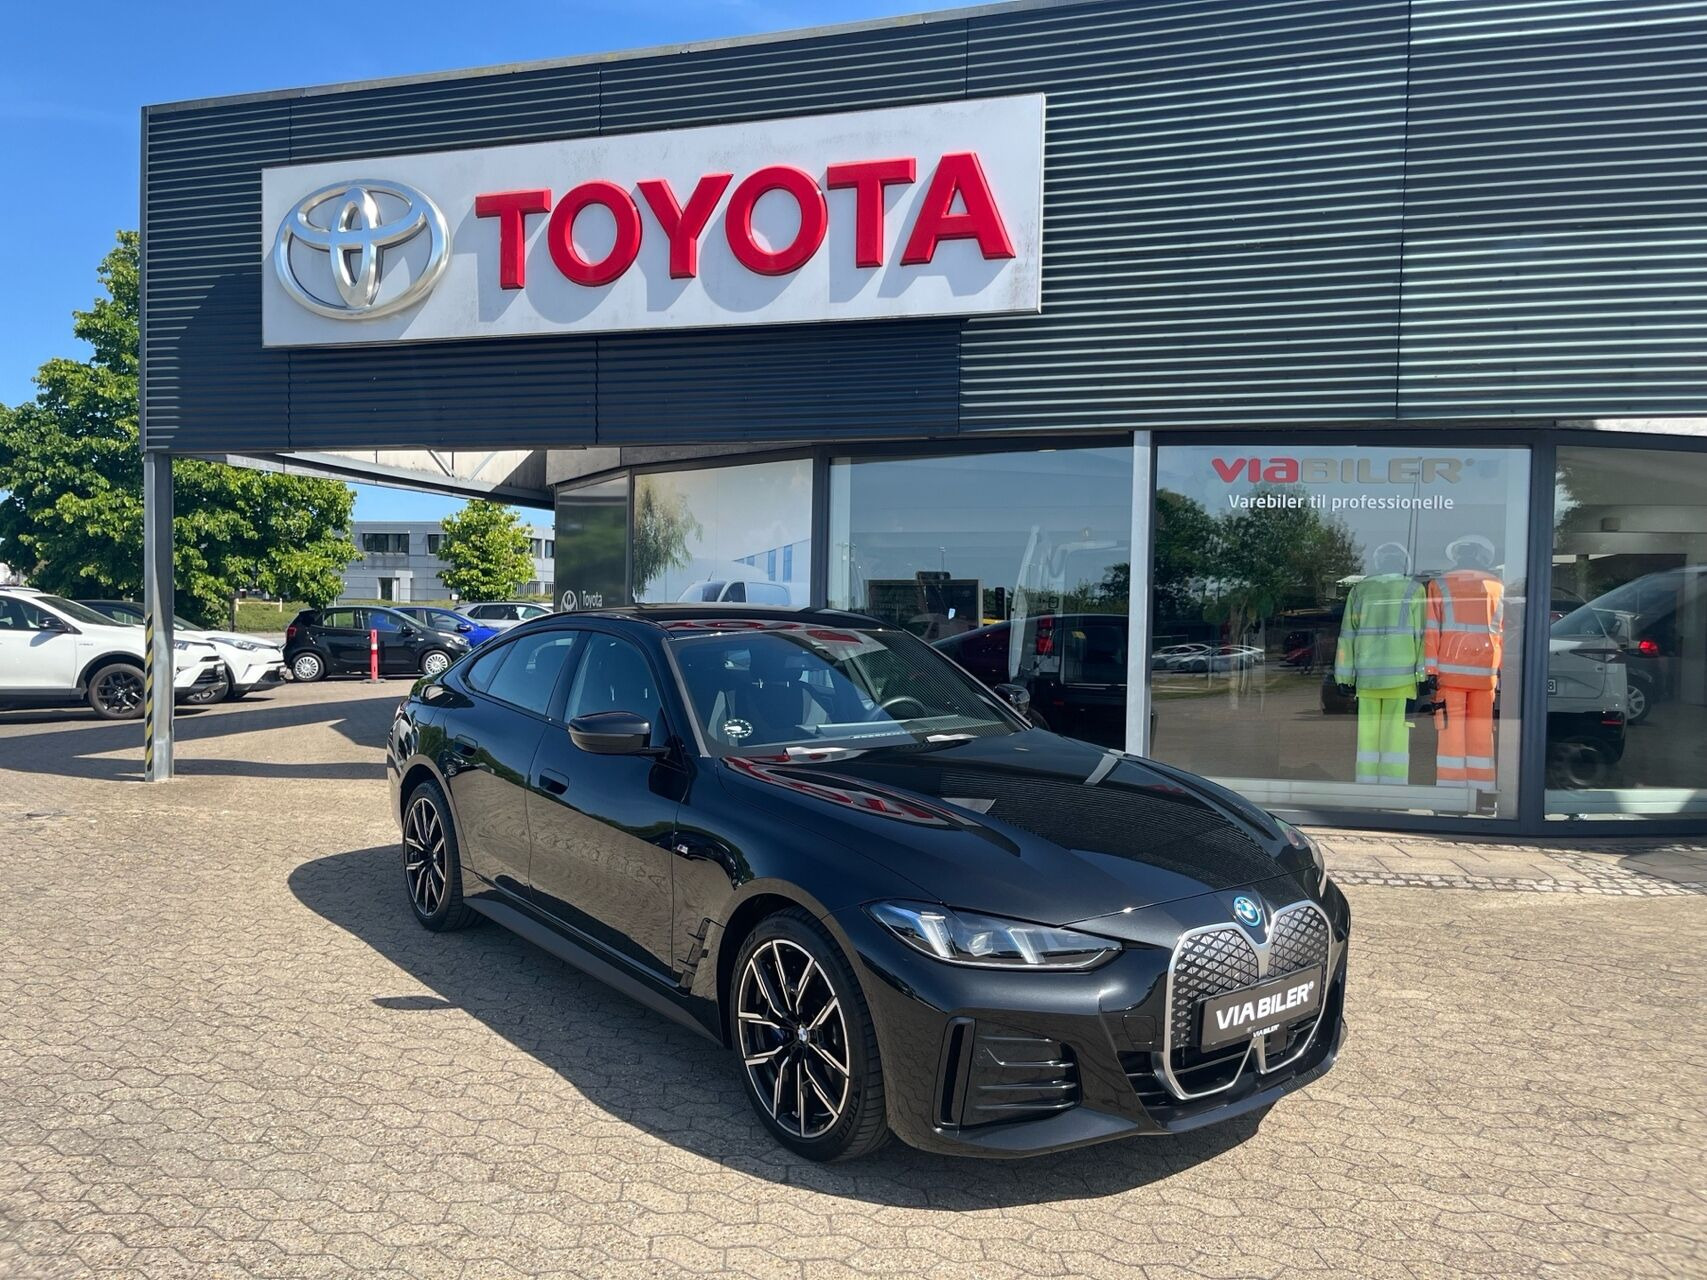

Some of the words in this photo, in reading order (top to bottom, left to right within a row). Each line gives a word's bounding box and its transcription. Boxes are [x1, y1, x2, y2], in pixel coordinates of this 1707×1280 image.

[475, 152, 1016, 290] TOYOTA
[1228, 494, 1304, 509] Varebiler
[1310, 494, 1326, 509] til
[1332, 494, 1454, 511] professionelle
[582, 590, 603, 608] Toyota
